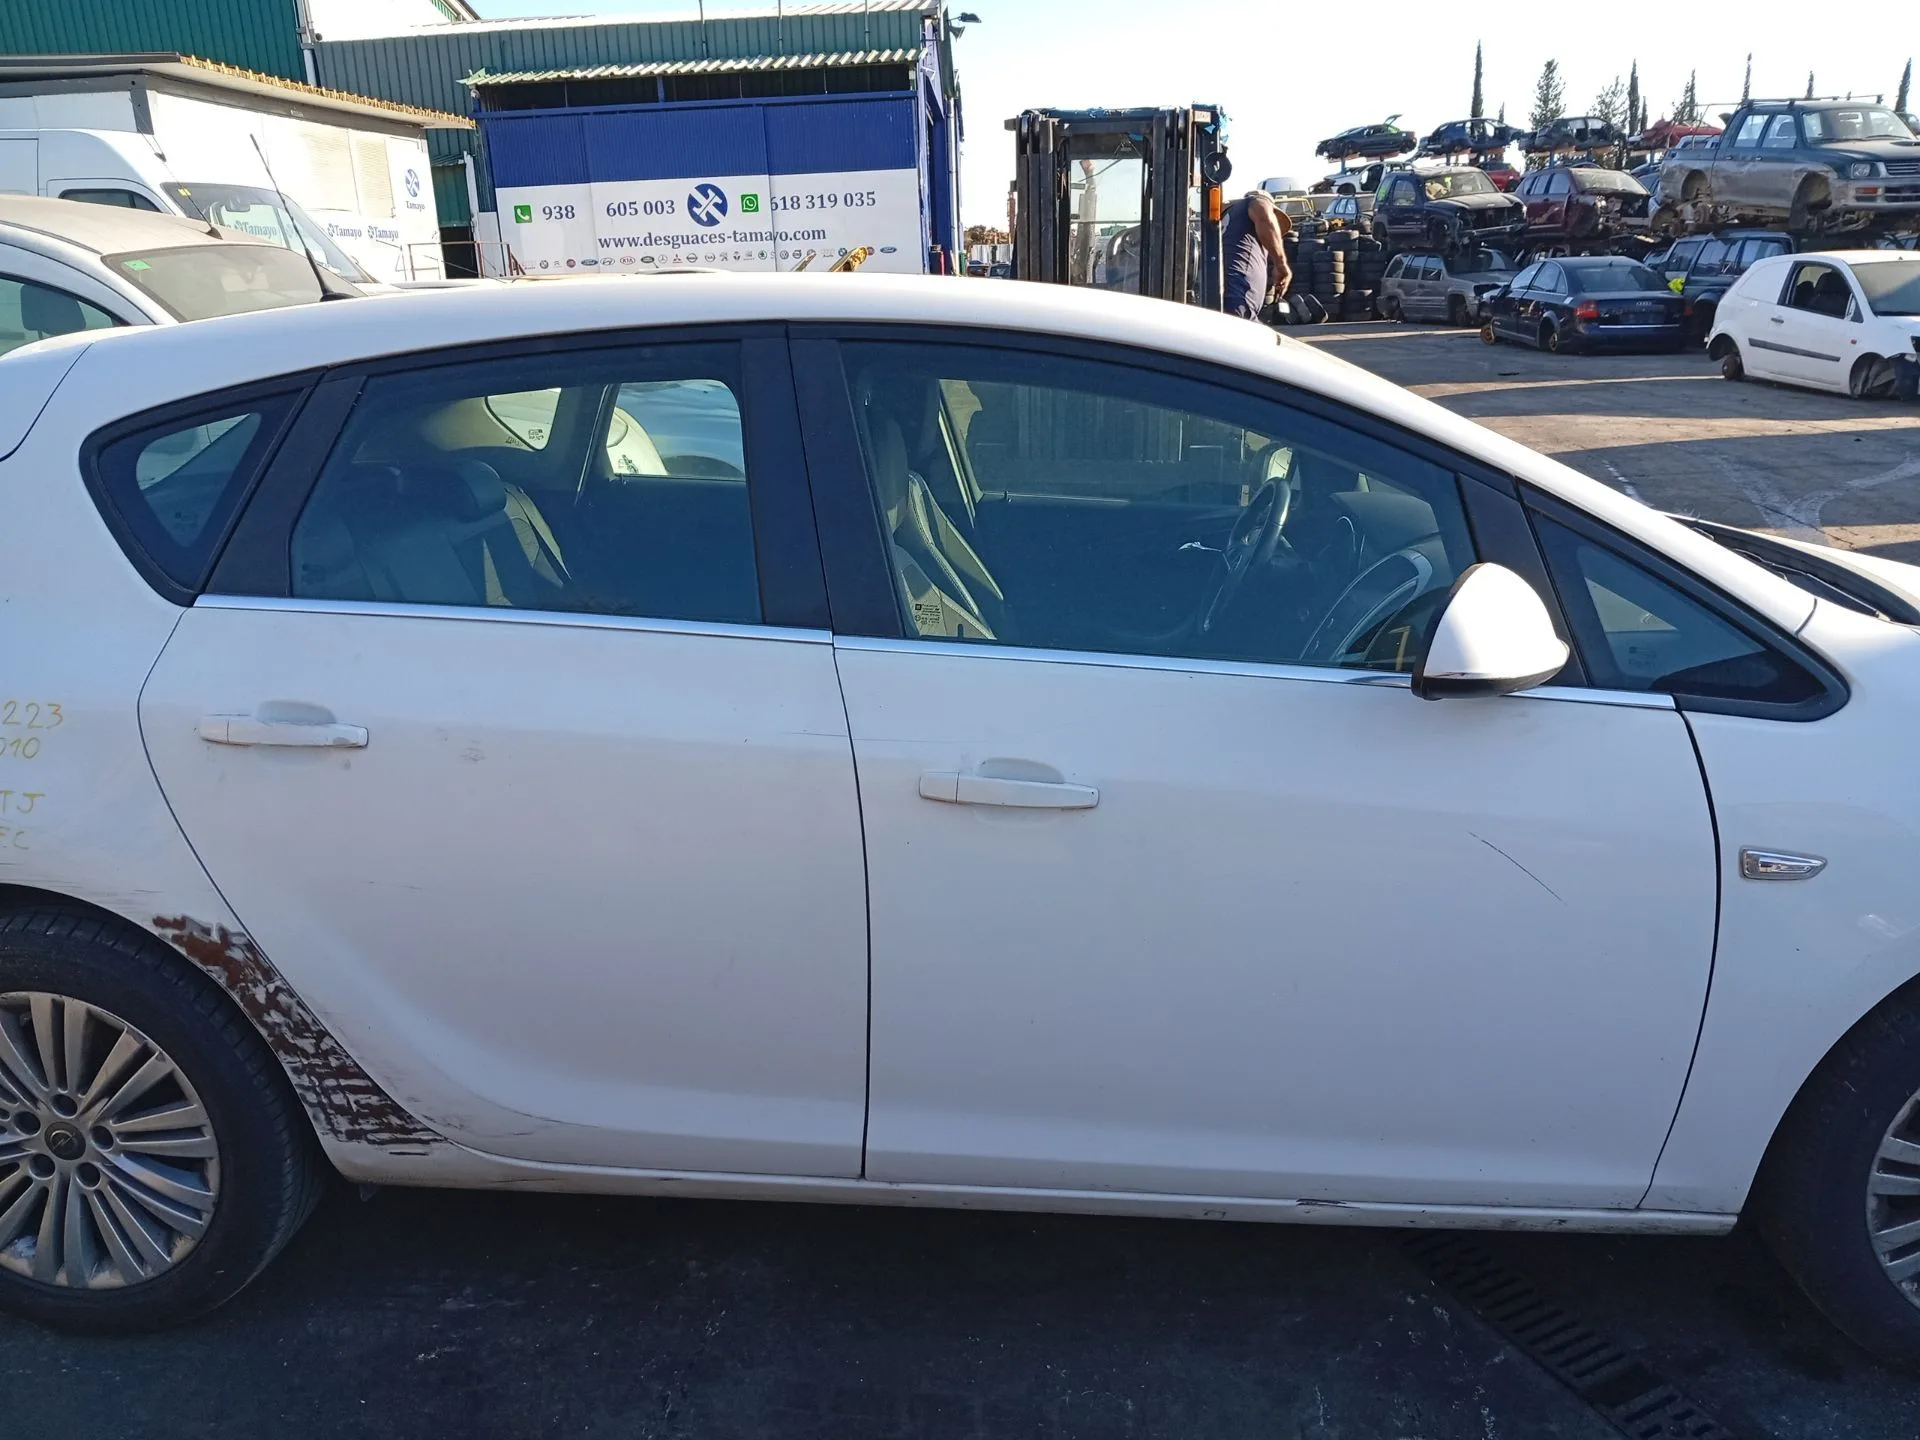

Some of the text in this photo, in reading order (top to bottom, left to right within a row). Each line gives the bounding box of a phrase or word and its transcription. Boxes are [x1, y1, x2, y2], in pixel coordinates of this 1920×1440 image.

[404, 200, 426, 211] Tamayo
[542, 199, 676, 221] 938 605 003
[770, 191, 876, 212] 618 319 035
[334, 224, 363, 240] Tamayo
[373, 225, 400, 242] Tamayo
[597, 228, 828, 250] www.desguaces-tamayo.com
[2, 700, 64, 730] 223
